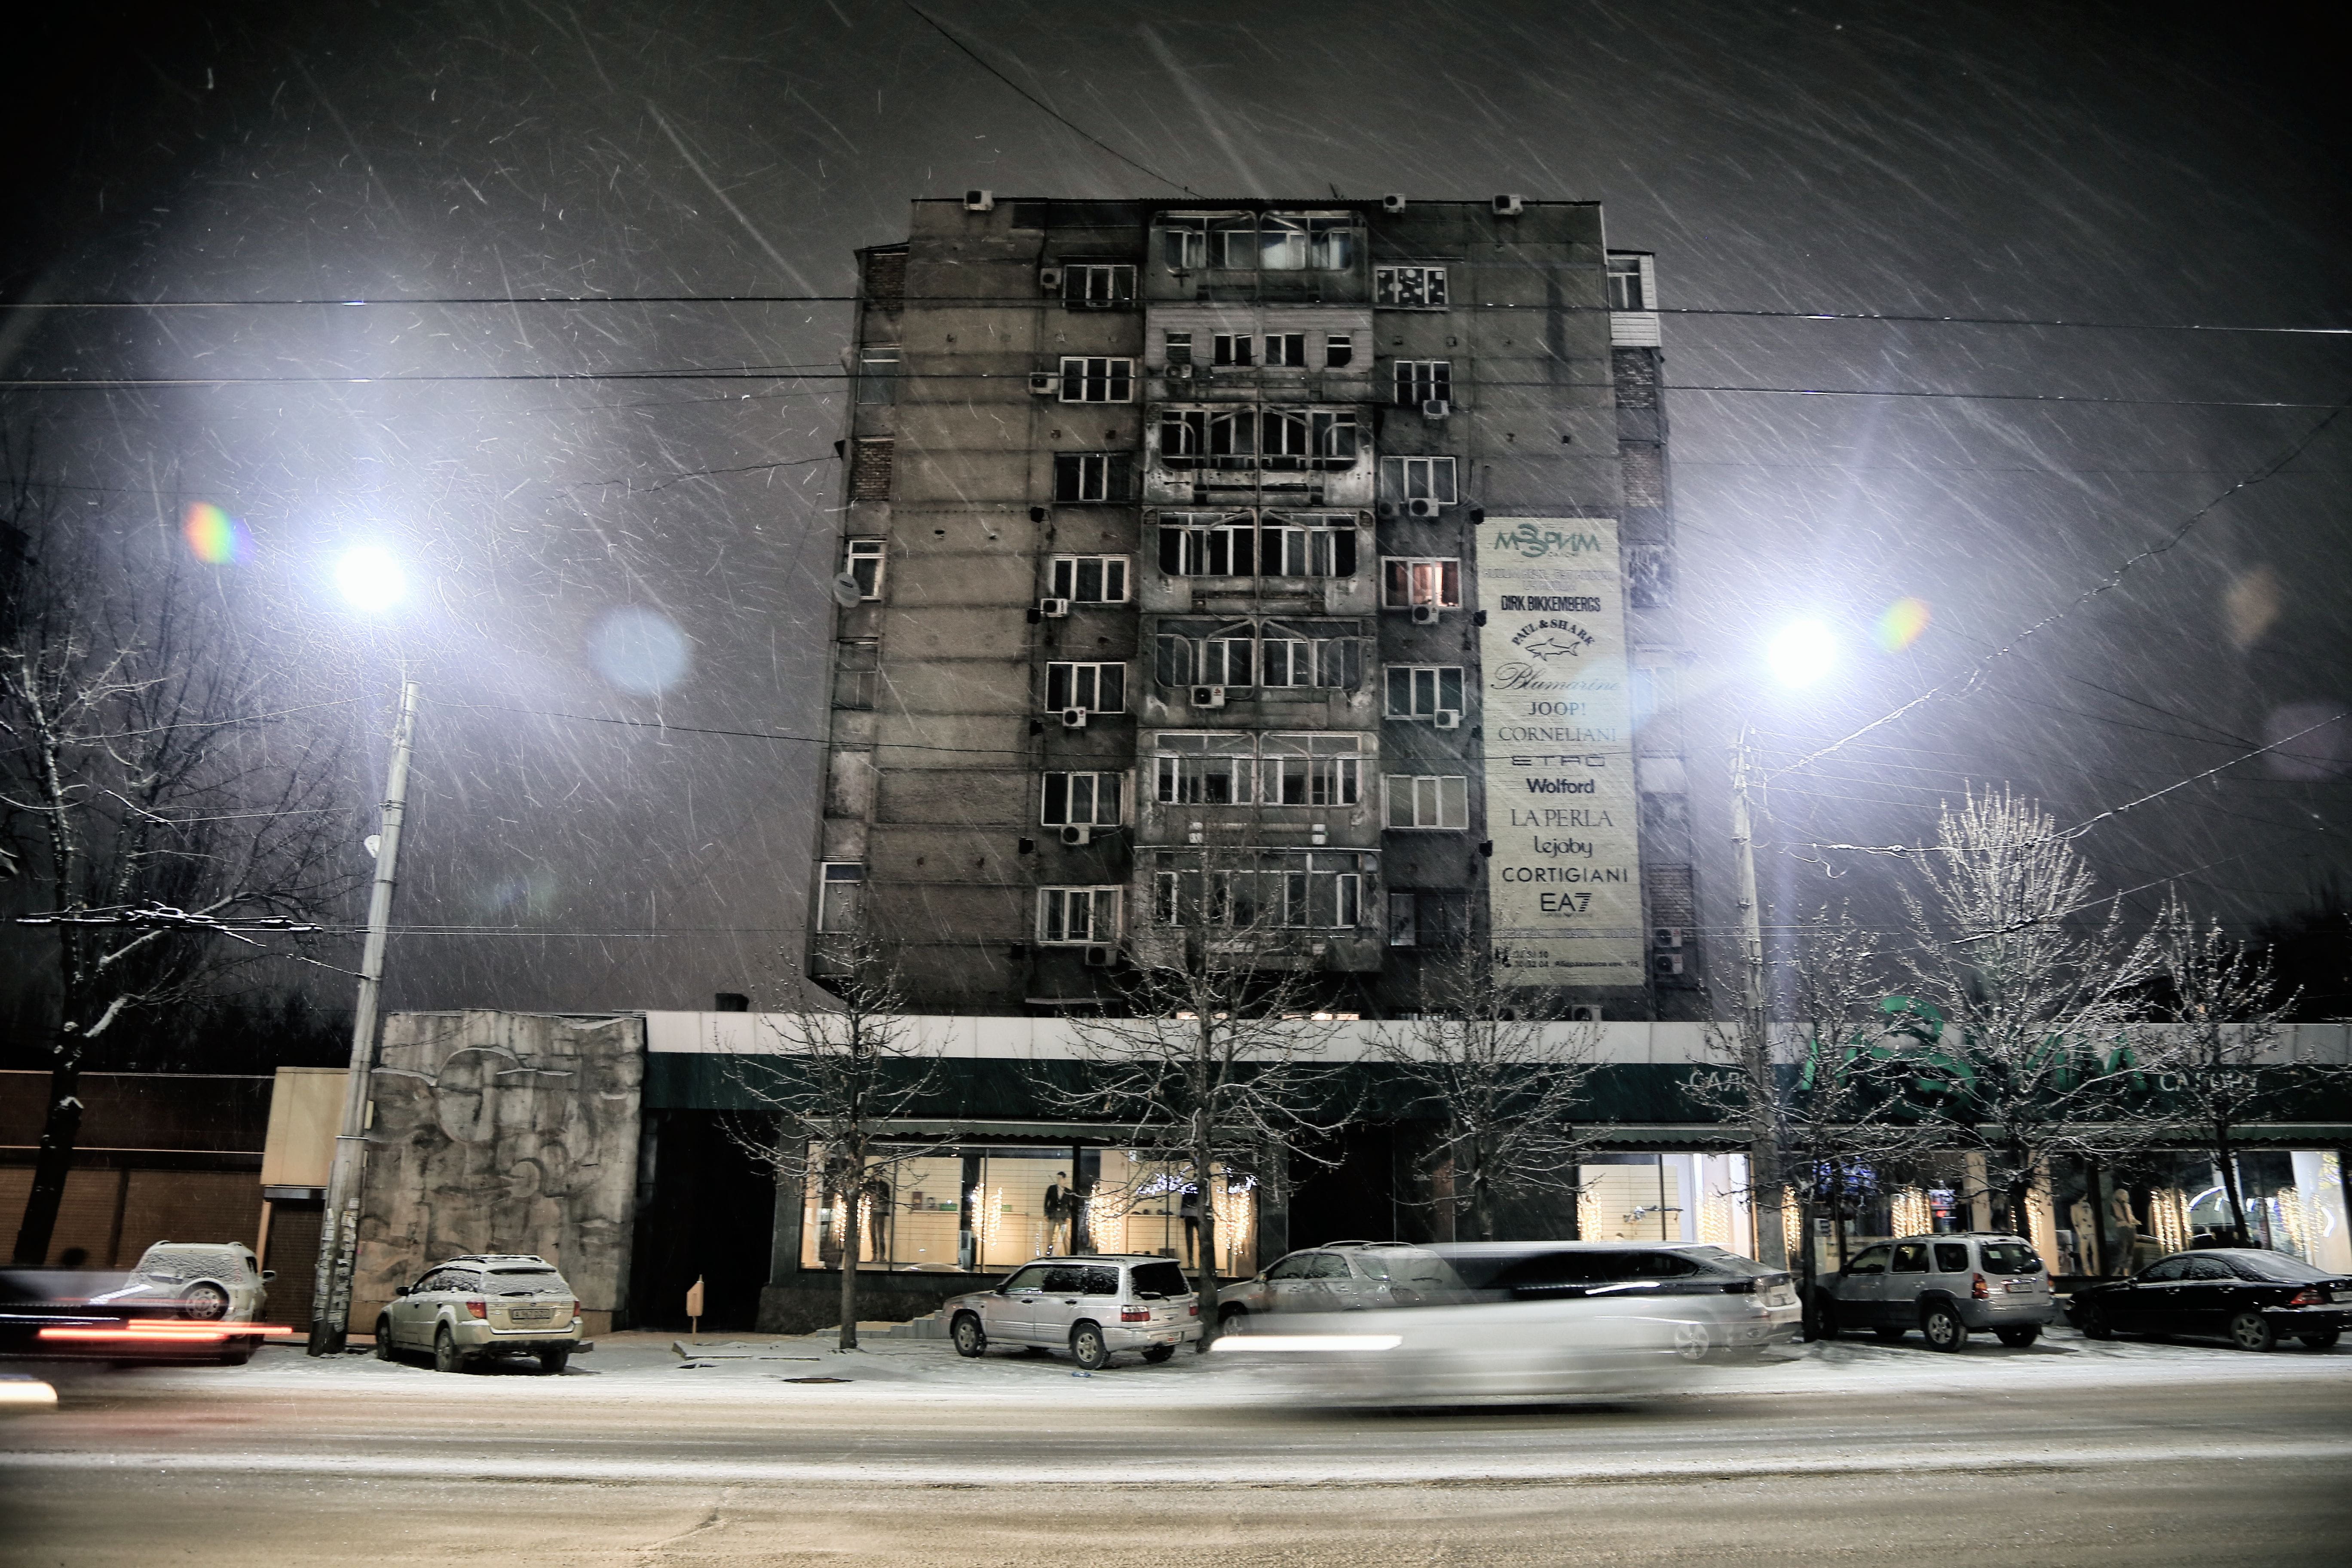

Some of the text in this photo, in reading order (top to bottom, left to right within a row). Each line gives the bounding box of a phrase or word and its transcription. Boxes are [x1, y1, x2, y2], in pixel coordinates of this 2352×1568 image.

[1501, 595, 1601, 612] DIRK BIKKEMBERGS
[1511, 619, 1595, 646] PAUL & SHARK
[1528, 702, 1585, 715] JOOP!
[1499, 727, 1616, 741] CORNELIANI
[1526, 778, 1595, 793] Wolford
[1511, 809, 1614, 827] LA PERLA
[1503, 867, 1628, 882] CORTIGIANI
[1541, 893, 1592, 912] EA7
